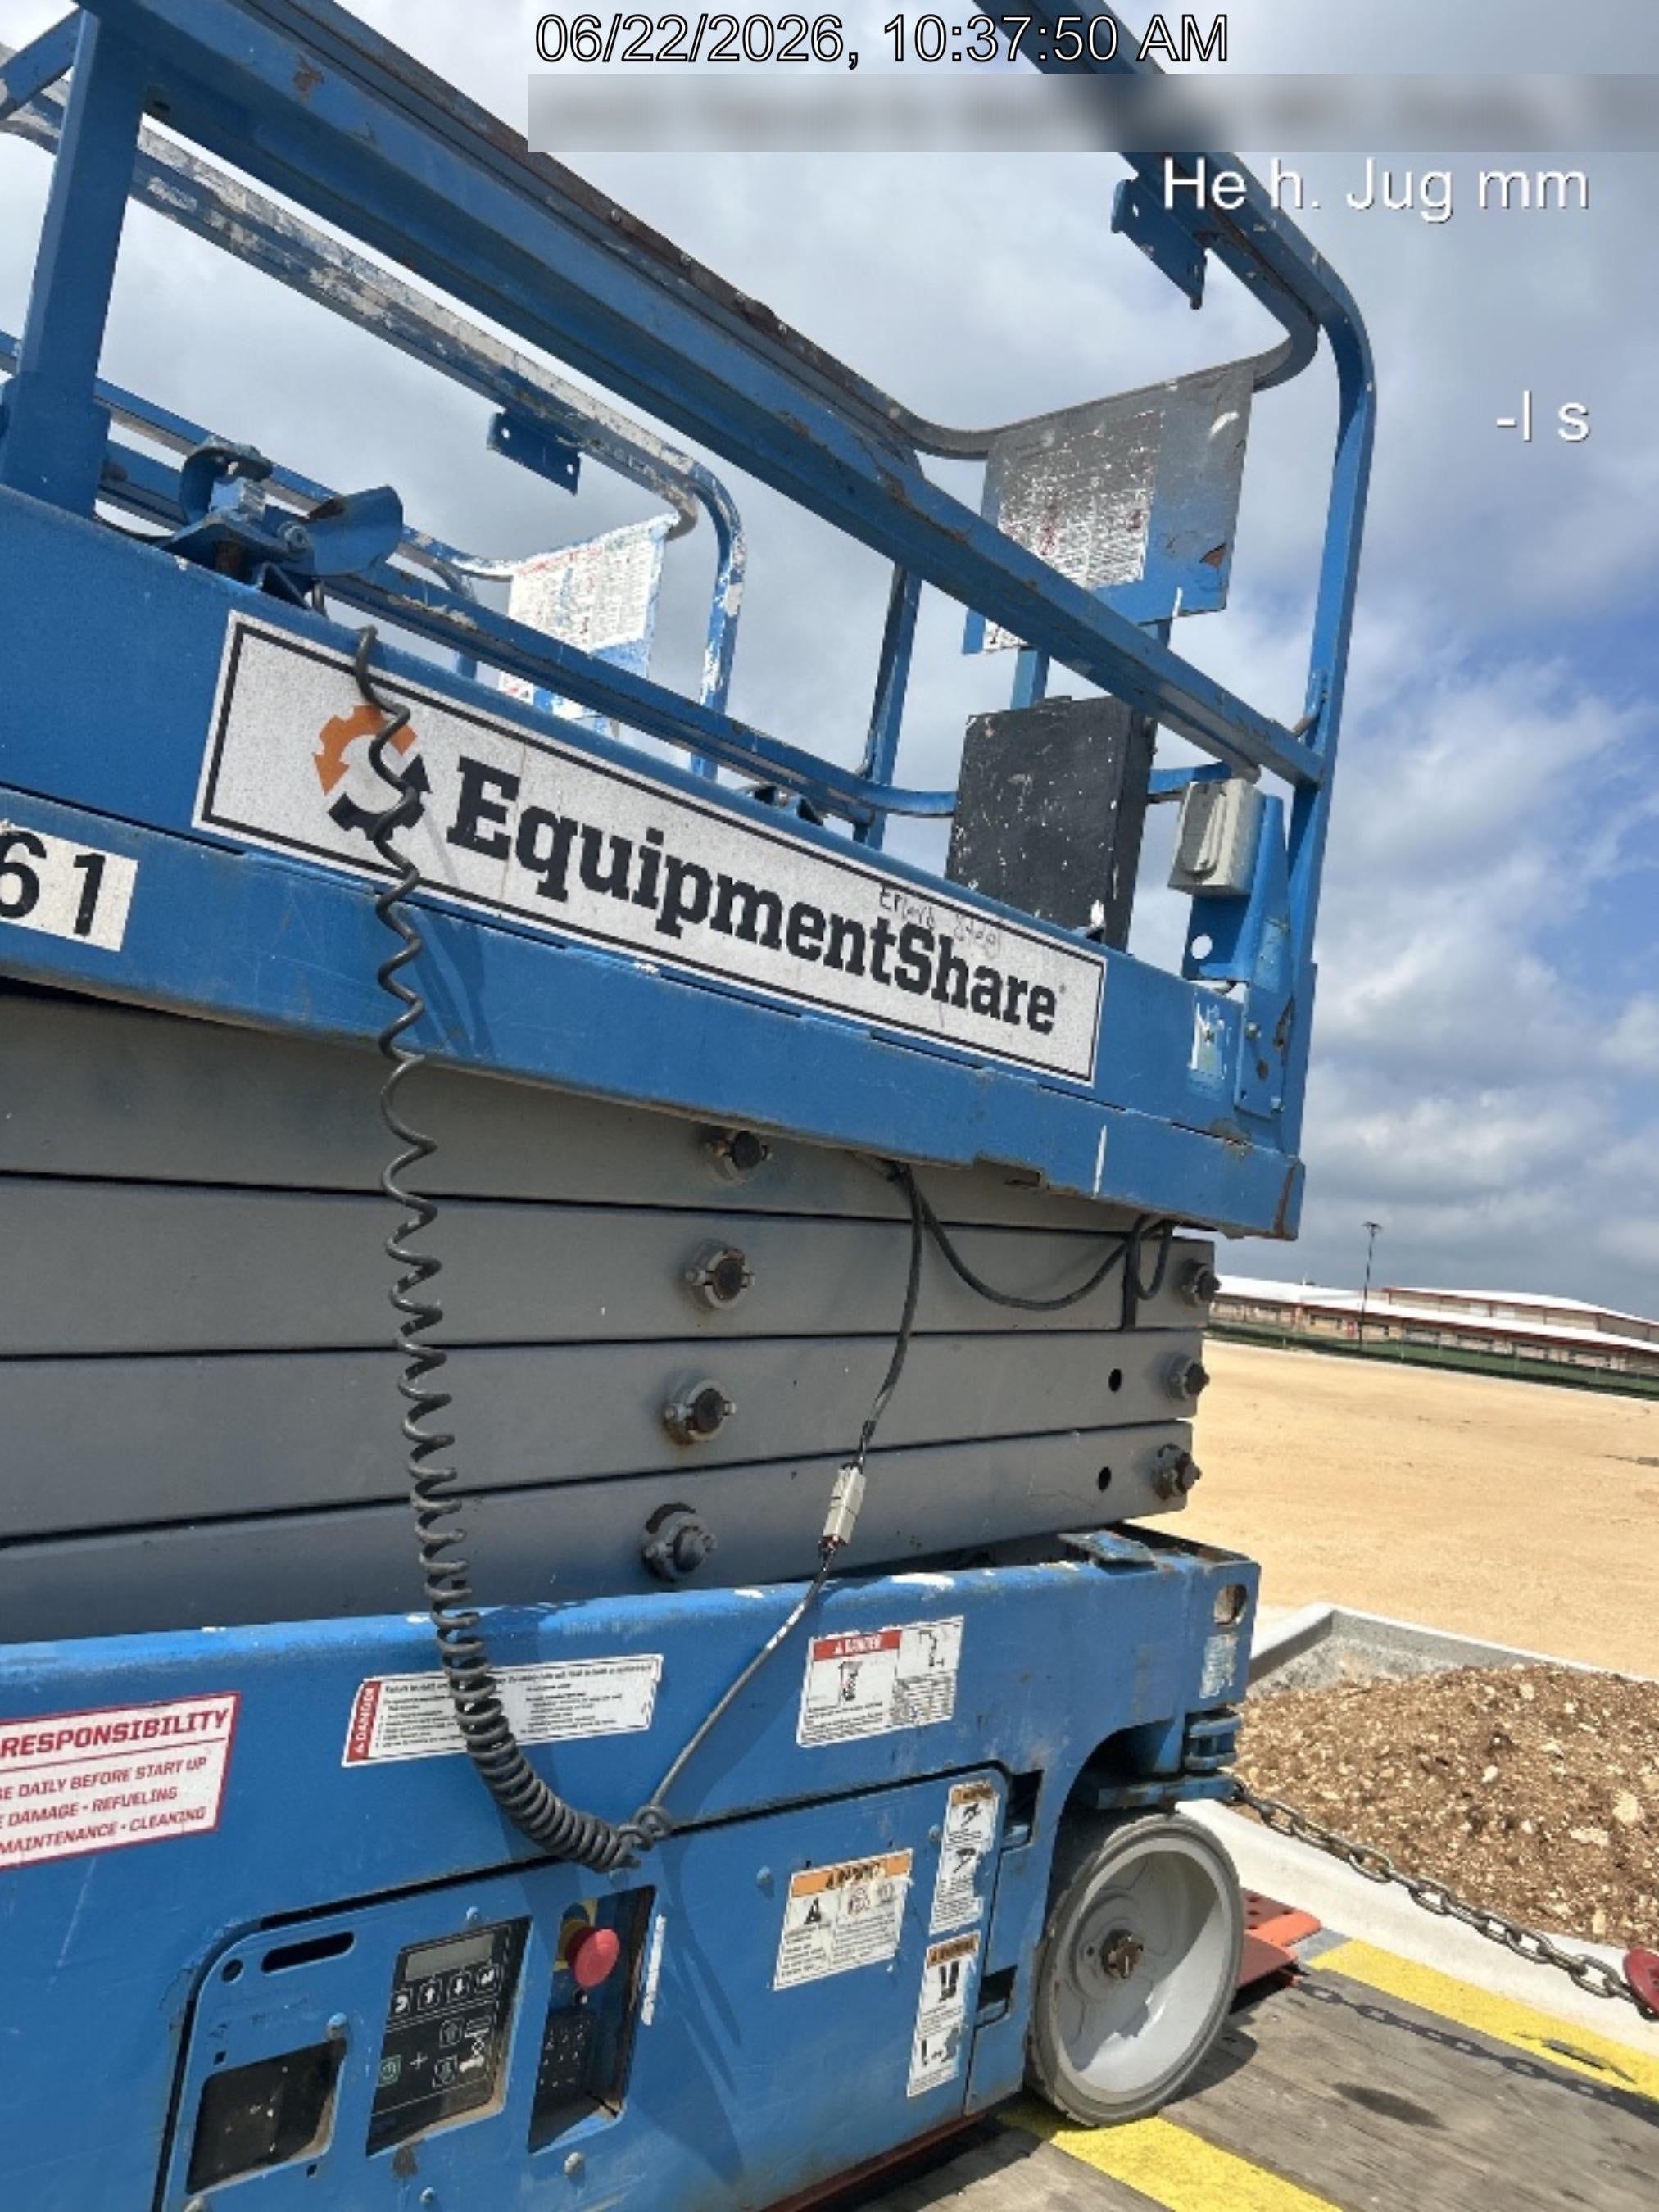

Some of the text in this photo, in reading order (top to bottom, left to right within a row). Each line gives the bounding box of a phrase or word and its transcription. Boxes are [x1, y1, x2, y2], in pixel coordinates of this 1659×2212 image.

[0, 831, 107, 936] 61
[446, 754, 1057, 1036] EquipmentShare
[0, 1708, 229, 1758] RESPONSIBILITY
[18, 1778, 67, 1797] DAILY
[70, 1767, 132, 1790] BEFORE
[135, 1759, 184, 1780] START
[186, 1756, 207, 1770] UP
[0, 1821, 117, 1854] MAINTENANCE
[129, 1806, 206, 1832] CLEANING
[8, 1802, 79, 1827] DAMAGE
[93, 1787, 178, 1812] REFUELING
